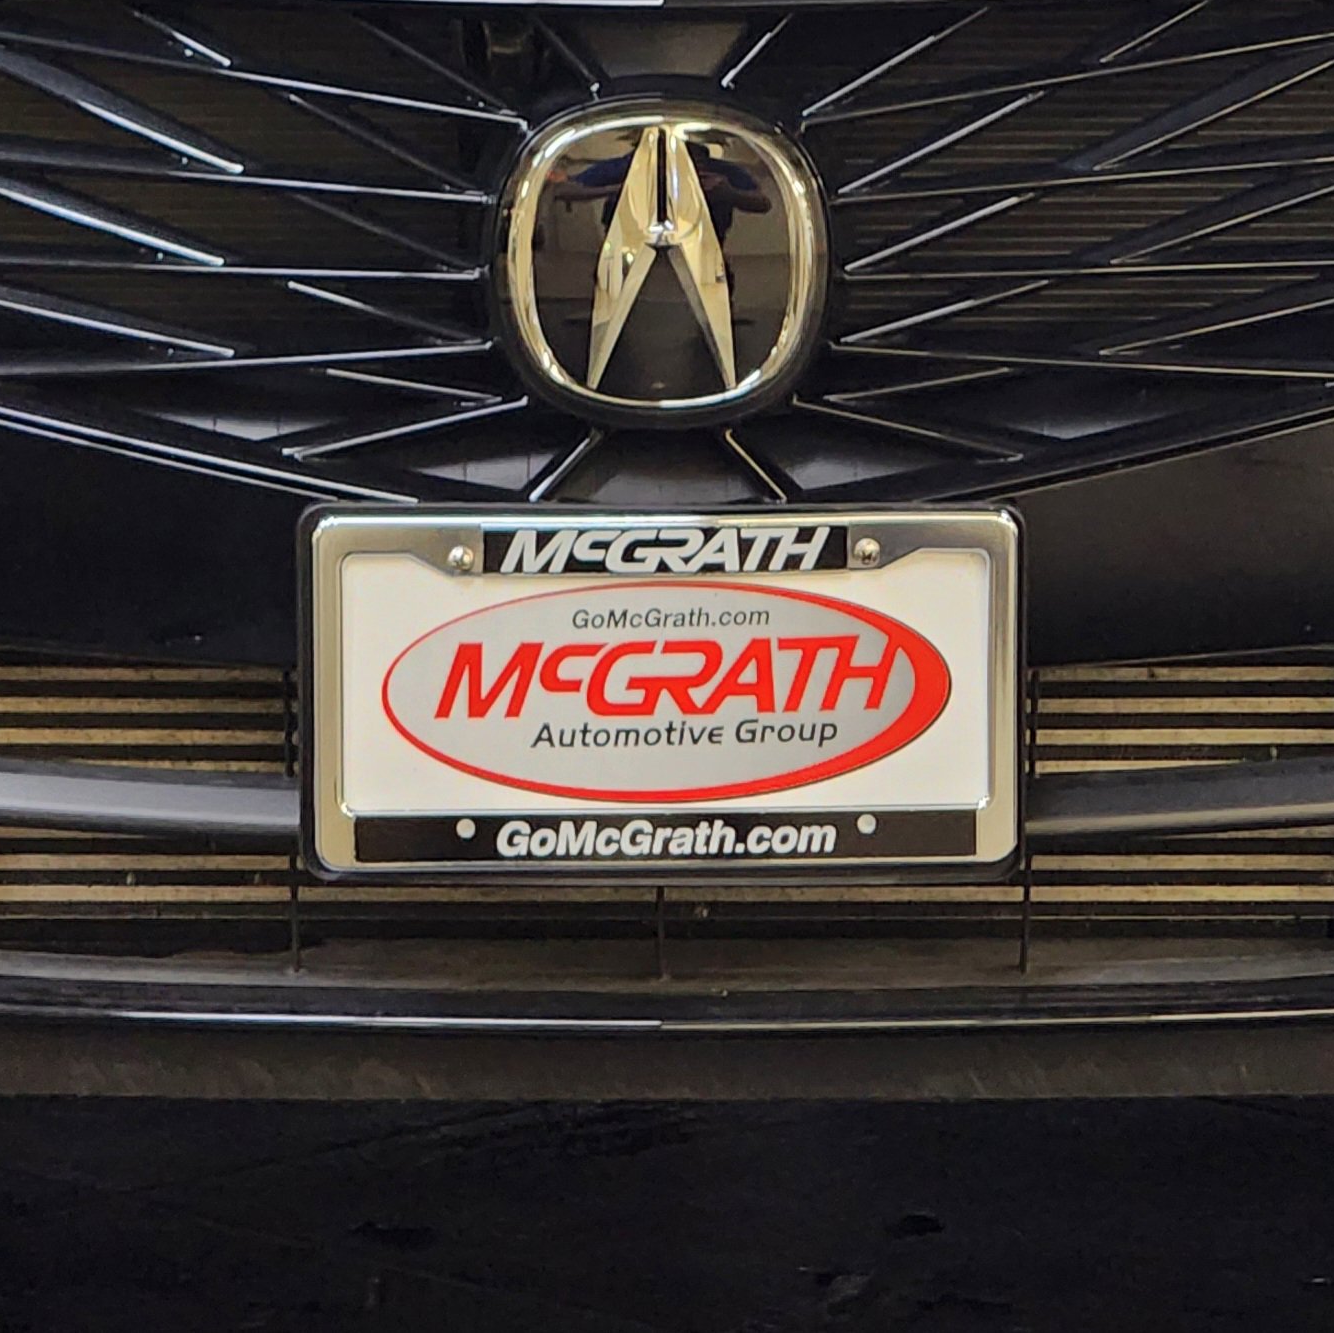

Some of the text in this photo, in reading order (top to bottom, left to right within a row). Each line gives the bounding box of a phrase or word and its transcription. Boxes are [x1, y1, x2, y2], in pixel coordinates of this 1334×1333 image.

[572, 608, 770, 630] GoMcGrath.com
[531, 719, 838, 749] Automotive Group
[497, 819, 836, 857] GoMcGrath.com
